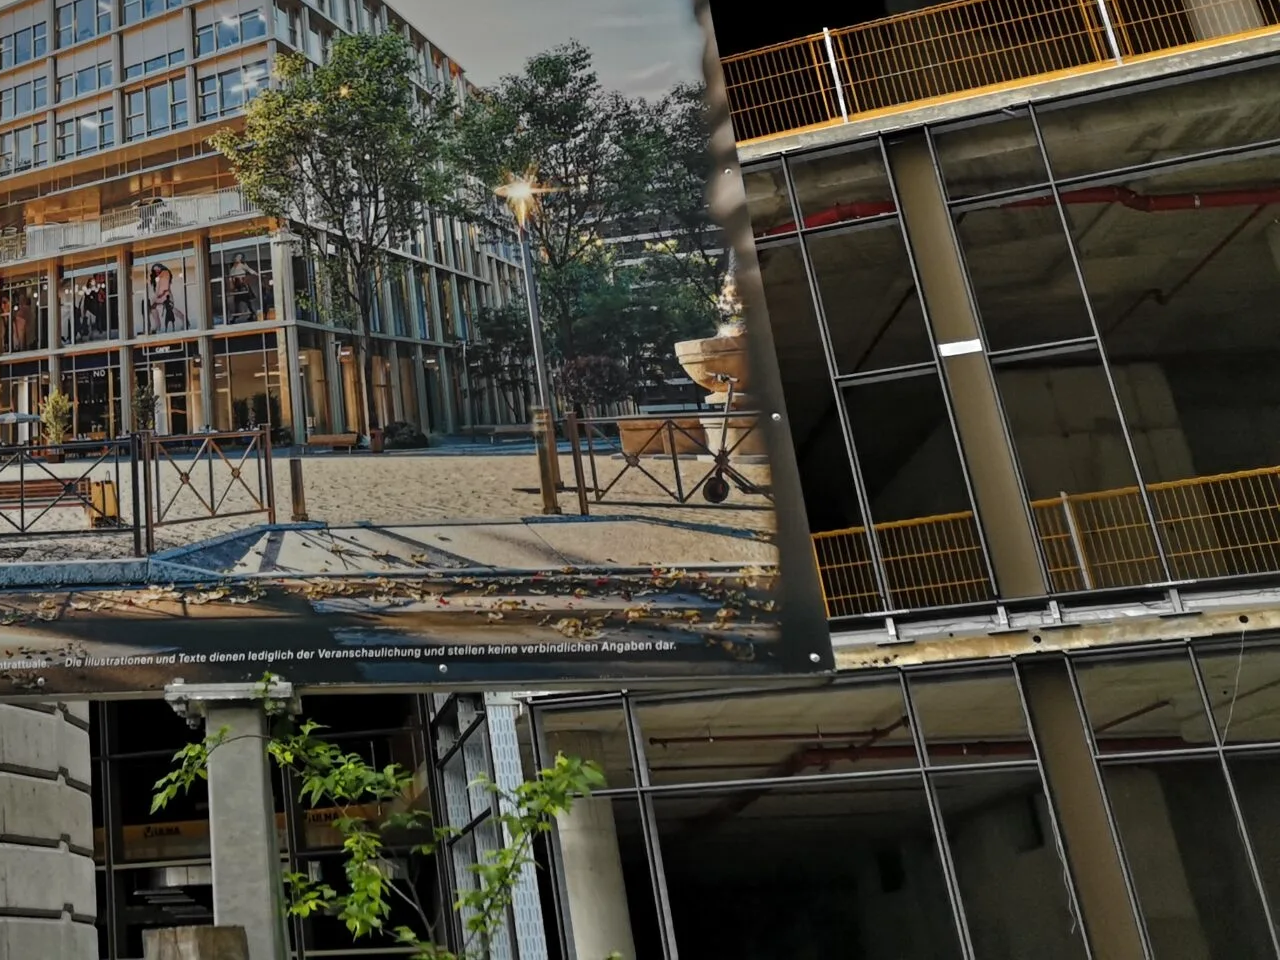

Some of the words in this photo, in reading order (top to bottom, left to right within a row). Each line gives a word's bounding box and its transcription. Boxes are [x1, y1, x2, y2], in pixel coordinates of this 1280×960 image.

[65, 656, 82, 668] Die
[84, 654, 153, 667] Illustrationen
[156, 653, 175, 664] und
[178, 652, 206, 663] Texte
[209, 651, 245, 662] dienen
[248, 649, 294, 663] lediglich
[296, 649, 314, 660] der
[318, 645, 421, 659] Veranschaulichung
[424, 645, 445, 656] und
[447, 644, 485, 655] stellen
[488, 643, 518, 654] keine
[521, 641, 598, 654] verbindlichen
[601, 640, 652, 654] Angaben
[655, 640, 676, 651] dar.
